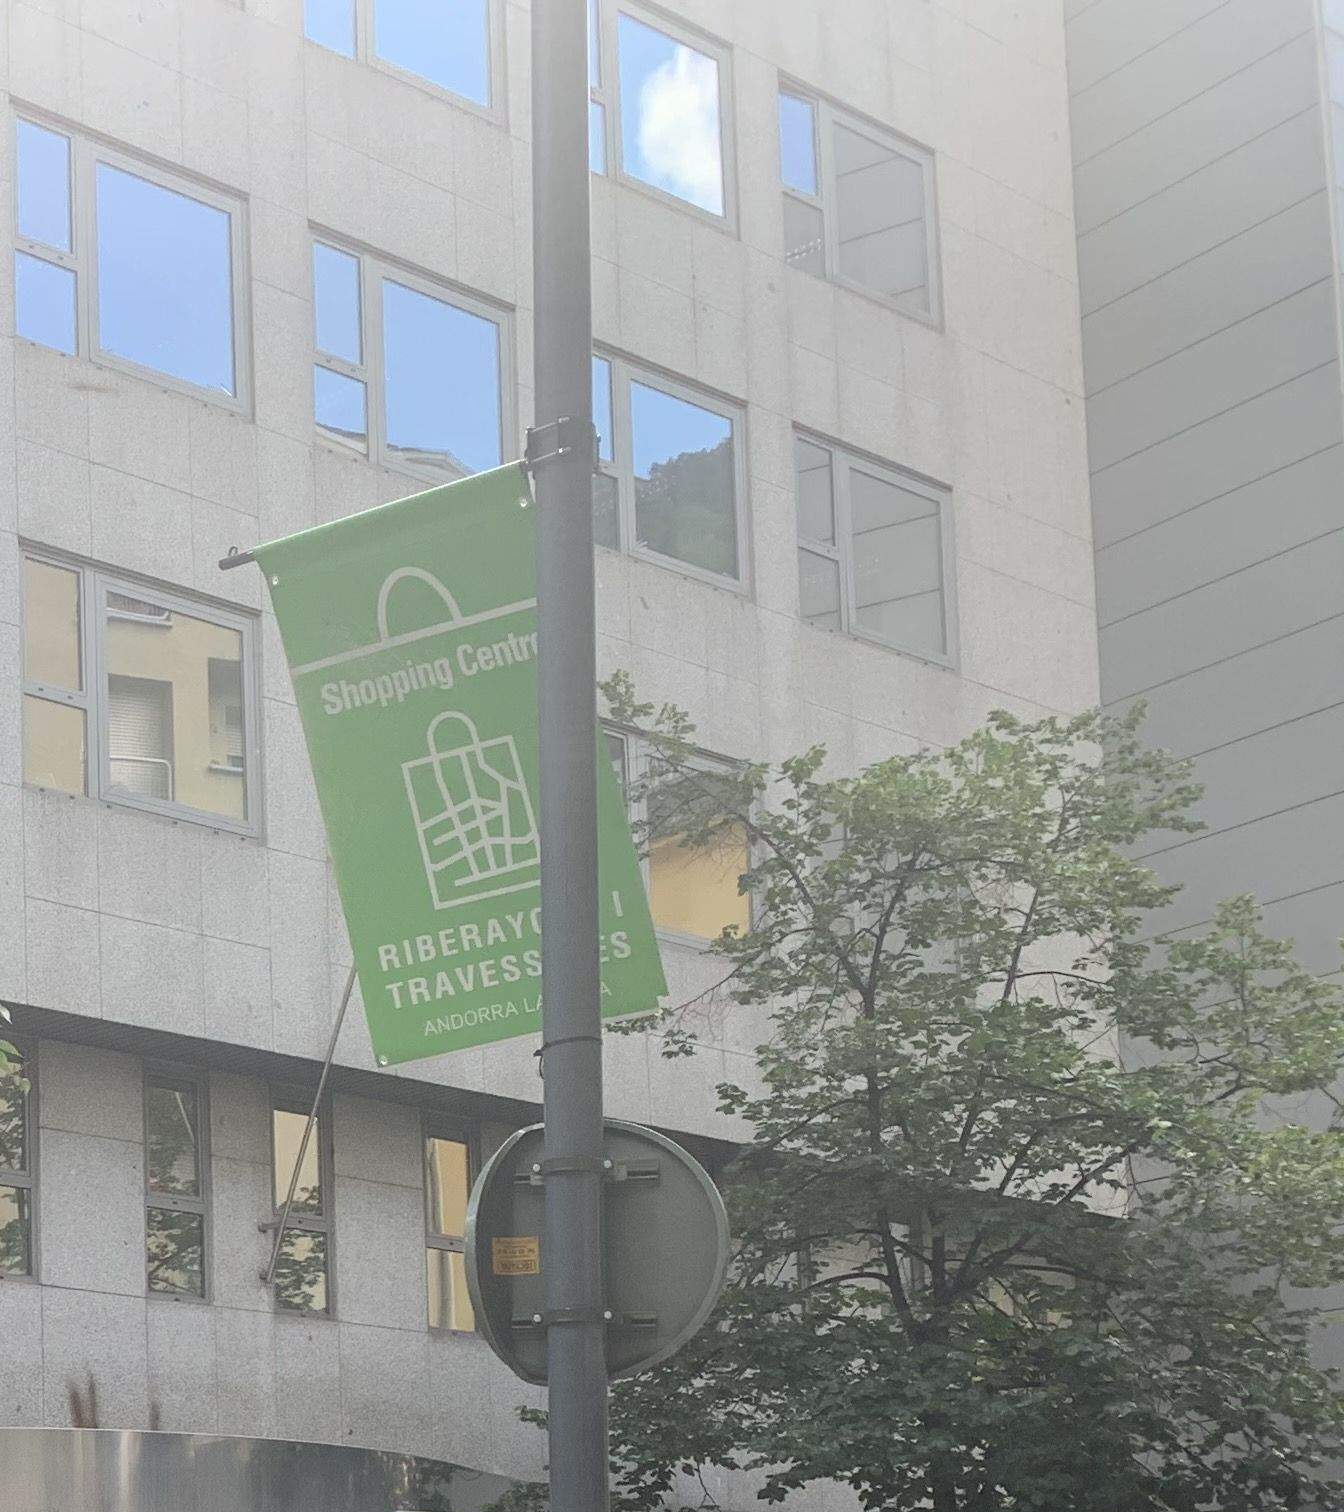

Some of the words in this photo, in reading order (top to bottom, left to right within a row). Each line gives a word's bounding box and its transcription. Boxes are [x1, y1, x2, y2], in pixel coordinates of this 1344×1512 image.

[320, 657, 454, 715] Shopping
[378, 906, 543, 972] RIBERAY
[385, 931, 632, 1010] TRAVESSES
[424, 1000, 519, 1037] ANDORRA
